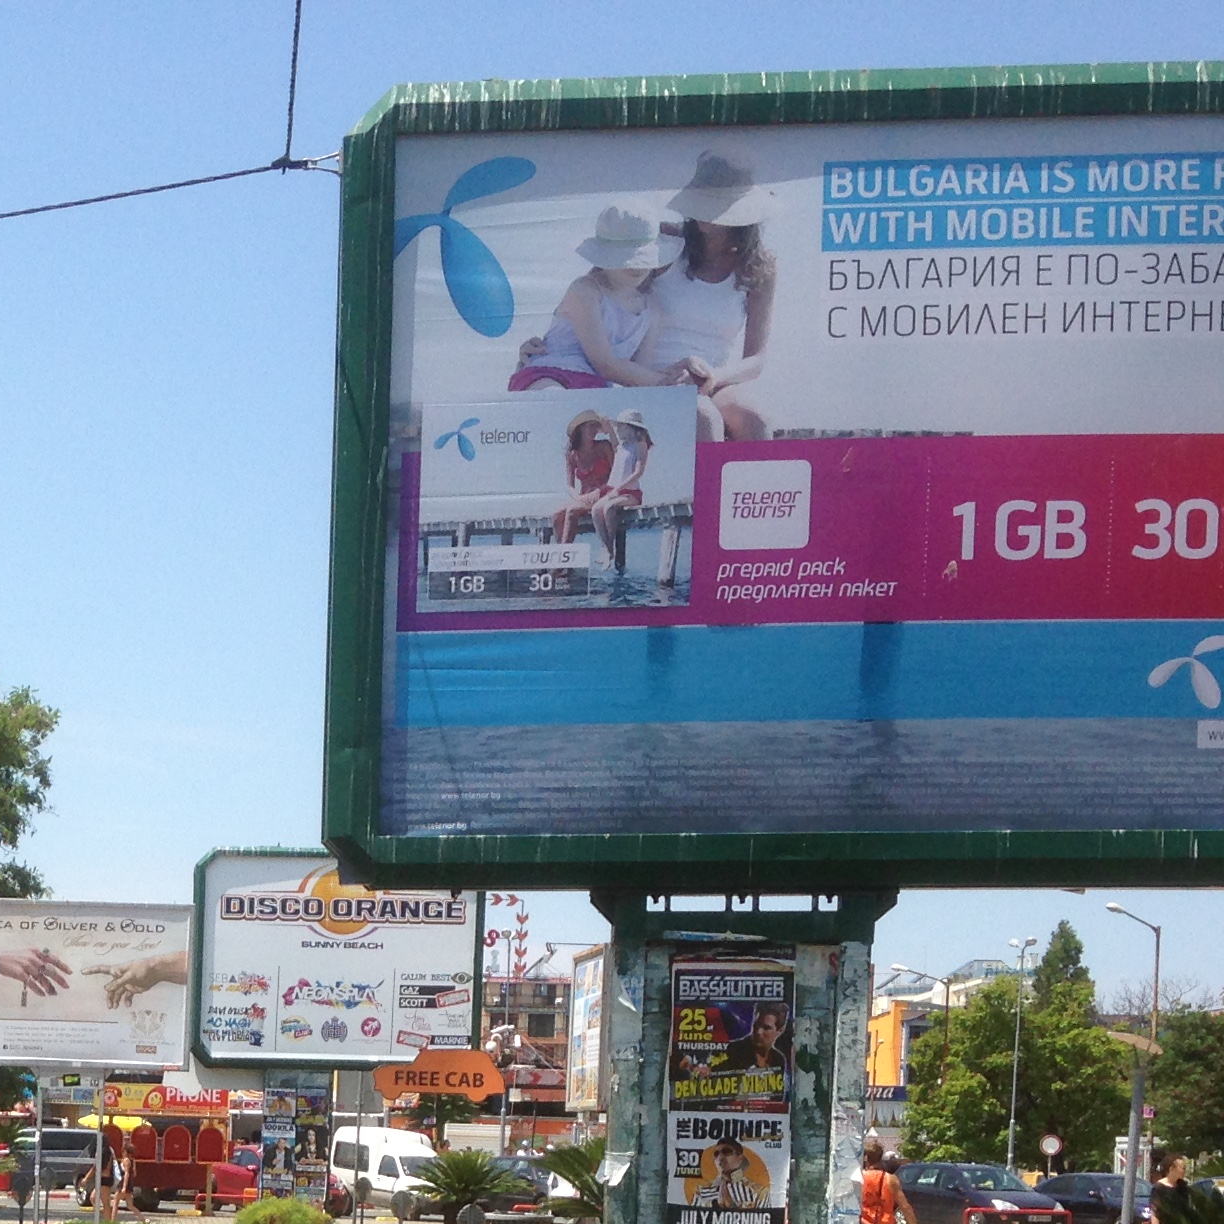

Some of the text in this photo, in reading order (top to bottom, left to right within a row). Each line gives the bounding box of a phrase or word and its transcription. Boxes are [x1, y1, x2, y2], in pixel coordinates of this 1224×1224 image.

[830, 161, 1031, 199] BULGARIA
[1040, 160, 1076, 194] IS
[1087, 157, 1201, 192] MORE
[827, 210, 933, 245] WITH
[946, 206, 1095, 241] MOBILE
[829, 254, 1021, 292] БЪЛГАРИЯ
[1036, 254, 1053, 287] Е
[827, 299, 1224, 339] С МОБИЛЕН ИНТЕРН
[480, 429, 531, 445] telenor
[1131, 498, 1221, 561] 30
[529, 574, 553, 592] 30
[222, 894, 467, 925] DISCO ORANGE
[20, 921, 39, 931] OF
[43, 916, 98, 932] SILVER
[105, 922, 116, 932] &
[120, 918, 166, 933] GOLD
[301, 940, 384, 950] SUNNY BEACH
[400, 986, 420, 995] GAZ
[679, 978, 784, 998] BASSHUNTER
[400, 998, 429, 1007] SCOTT
[679, 1007, 707, 1031] 25
[434, 1036, 469, 1045] MARNIE
[677, 1042, 730, 1051] THURSDAY
[394, 1070, 485, 1088] FREE CAB
[675, 1080, 697, 1099] DEN
[700, 1077, 738, 1097] GLADE
[677, 1117, 691, 1140] THE
[693, 1117, 783, 1142] BOUNCE
[764, 1141, 783, 1149] CLUB
[679, 1151, 699, 1167] 30
